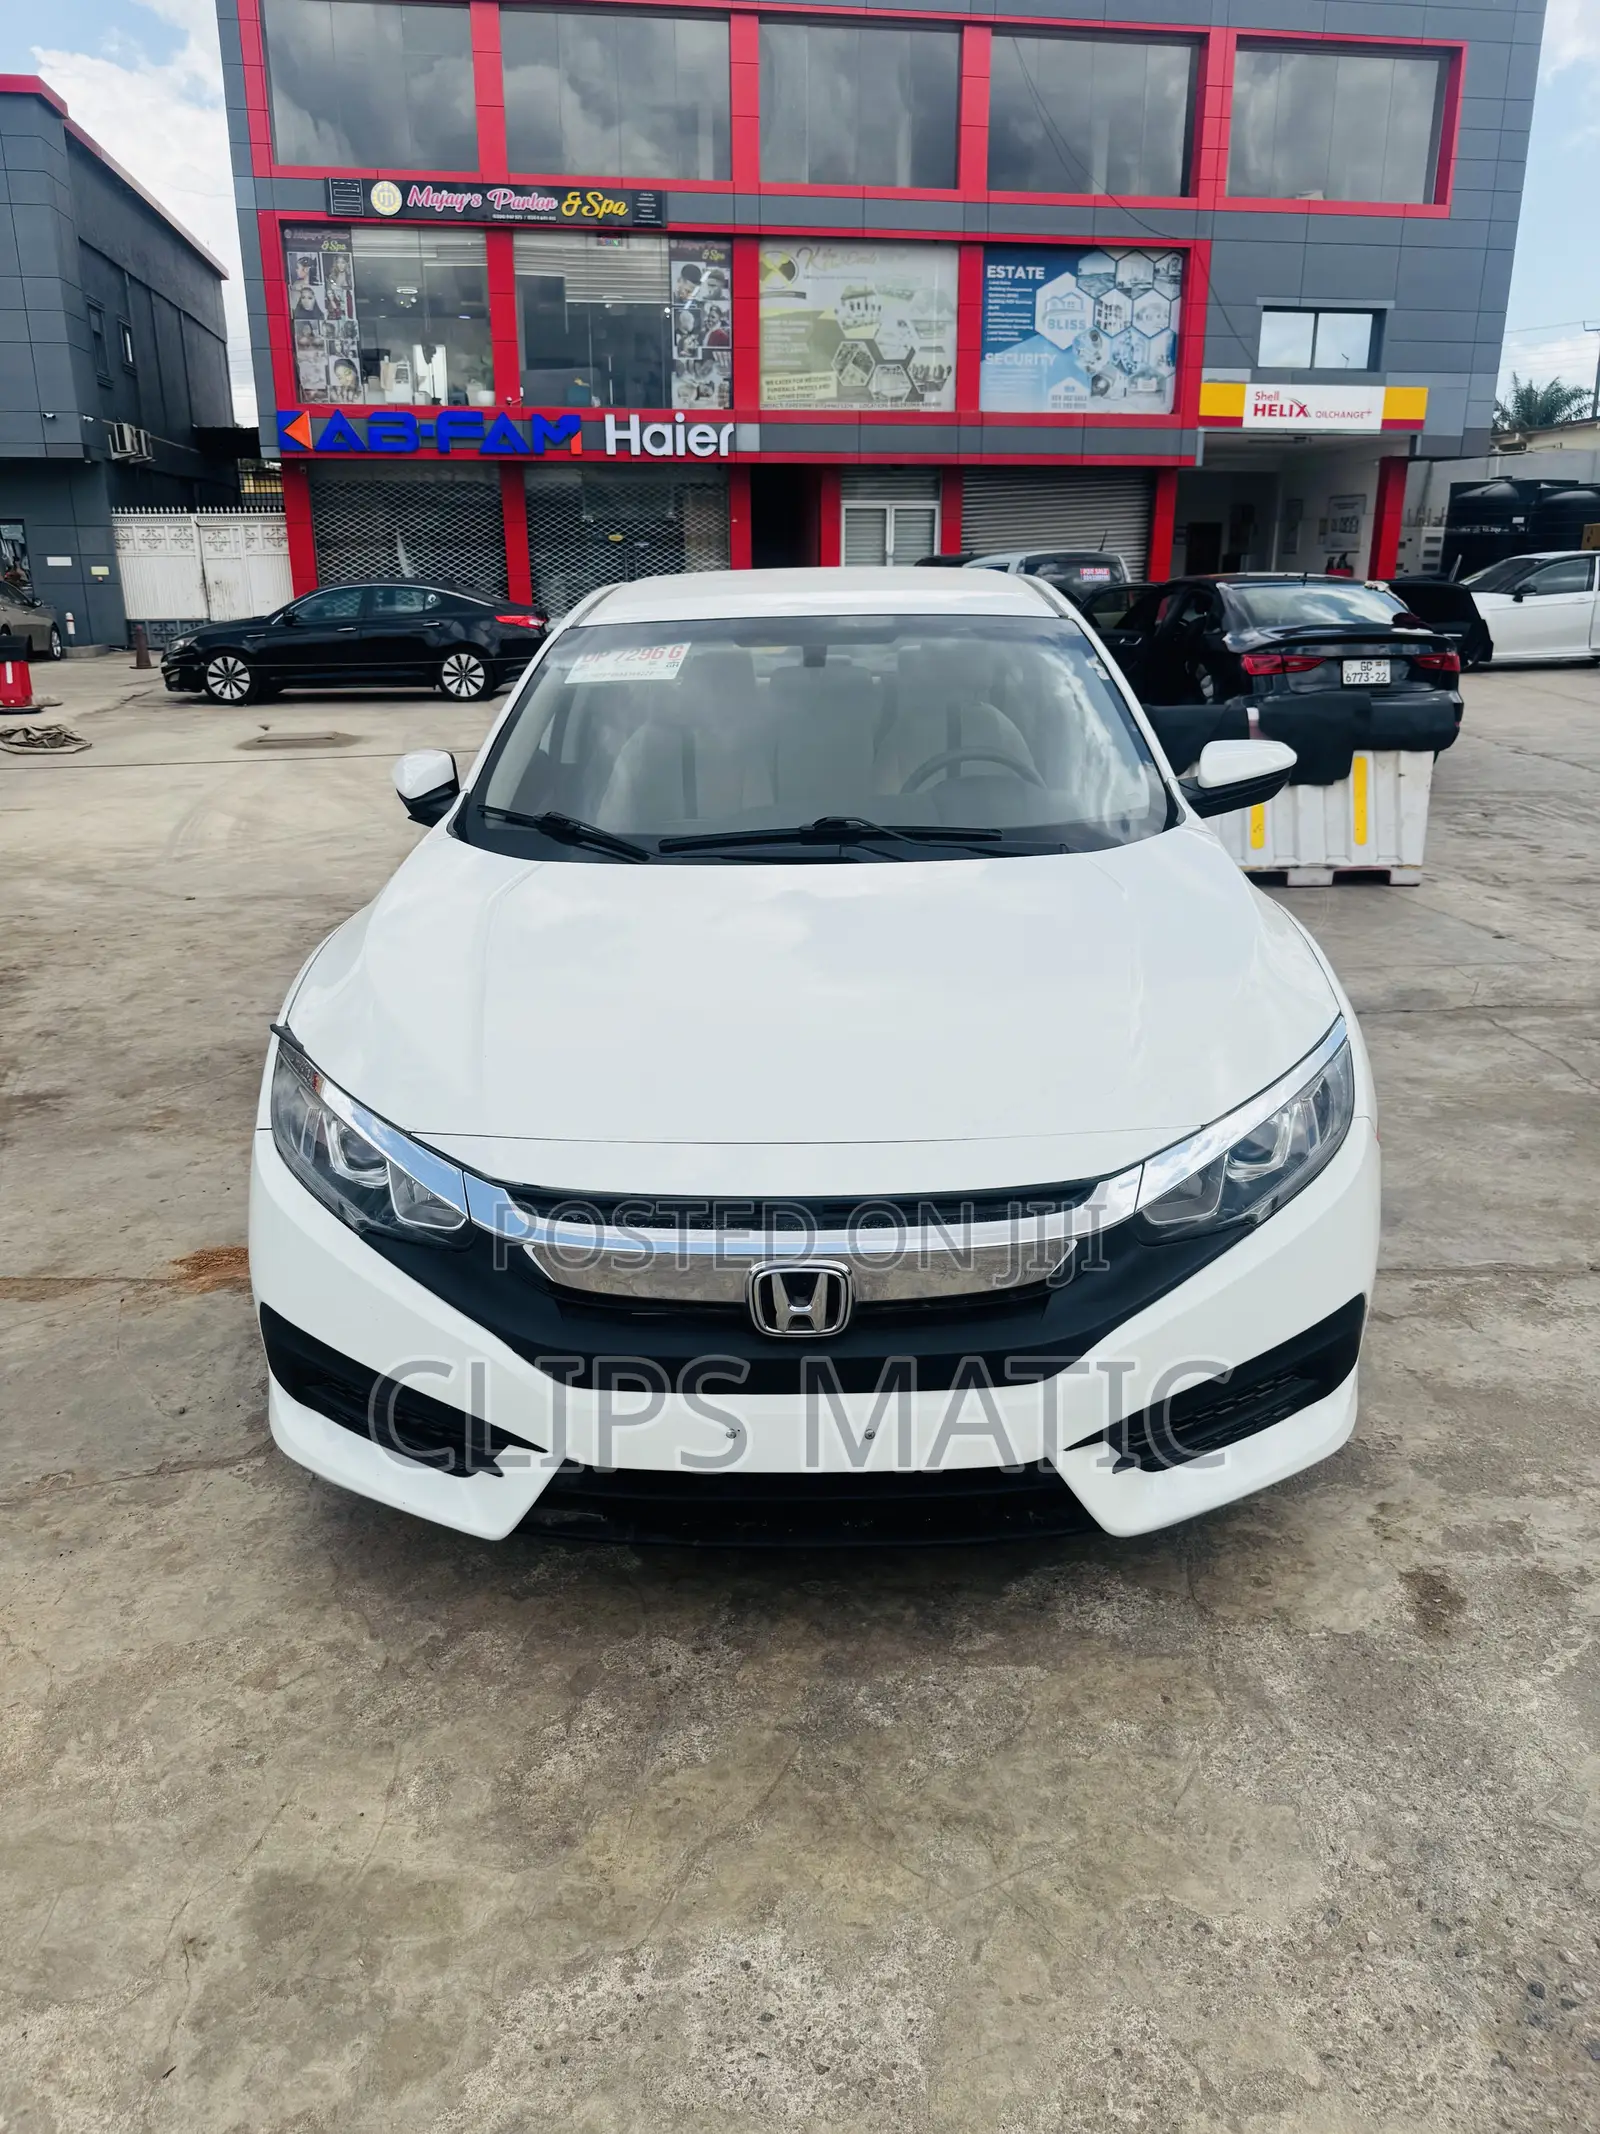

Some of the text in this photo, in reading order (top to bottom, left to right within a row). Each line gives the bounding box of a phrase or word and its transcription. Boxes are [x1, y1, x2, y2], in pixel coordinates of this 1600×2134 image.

[407, 185, 482, 213] Majay's
[487, 188, 559, 212] Parlor
[562, 192, 582, 217] &
[581, 191, 629, 219] Spa
[986, 265, 1046, 280] ESTATE
[1047, 319, 1087, 330] BLISS
[984, 352, 1057, 366] SECURITY
[1255, 391, 1280, 402] Shell
[1253, 402, 1309, 418] HELIX
[605, 412, 734, 457] Haier
[1360, 661, 1373, 671] GC
[1345, 672, 1387, 683] 6773-22
